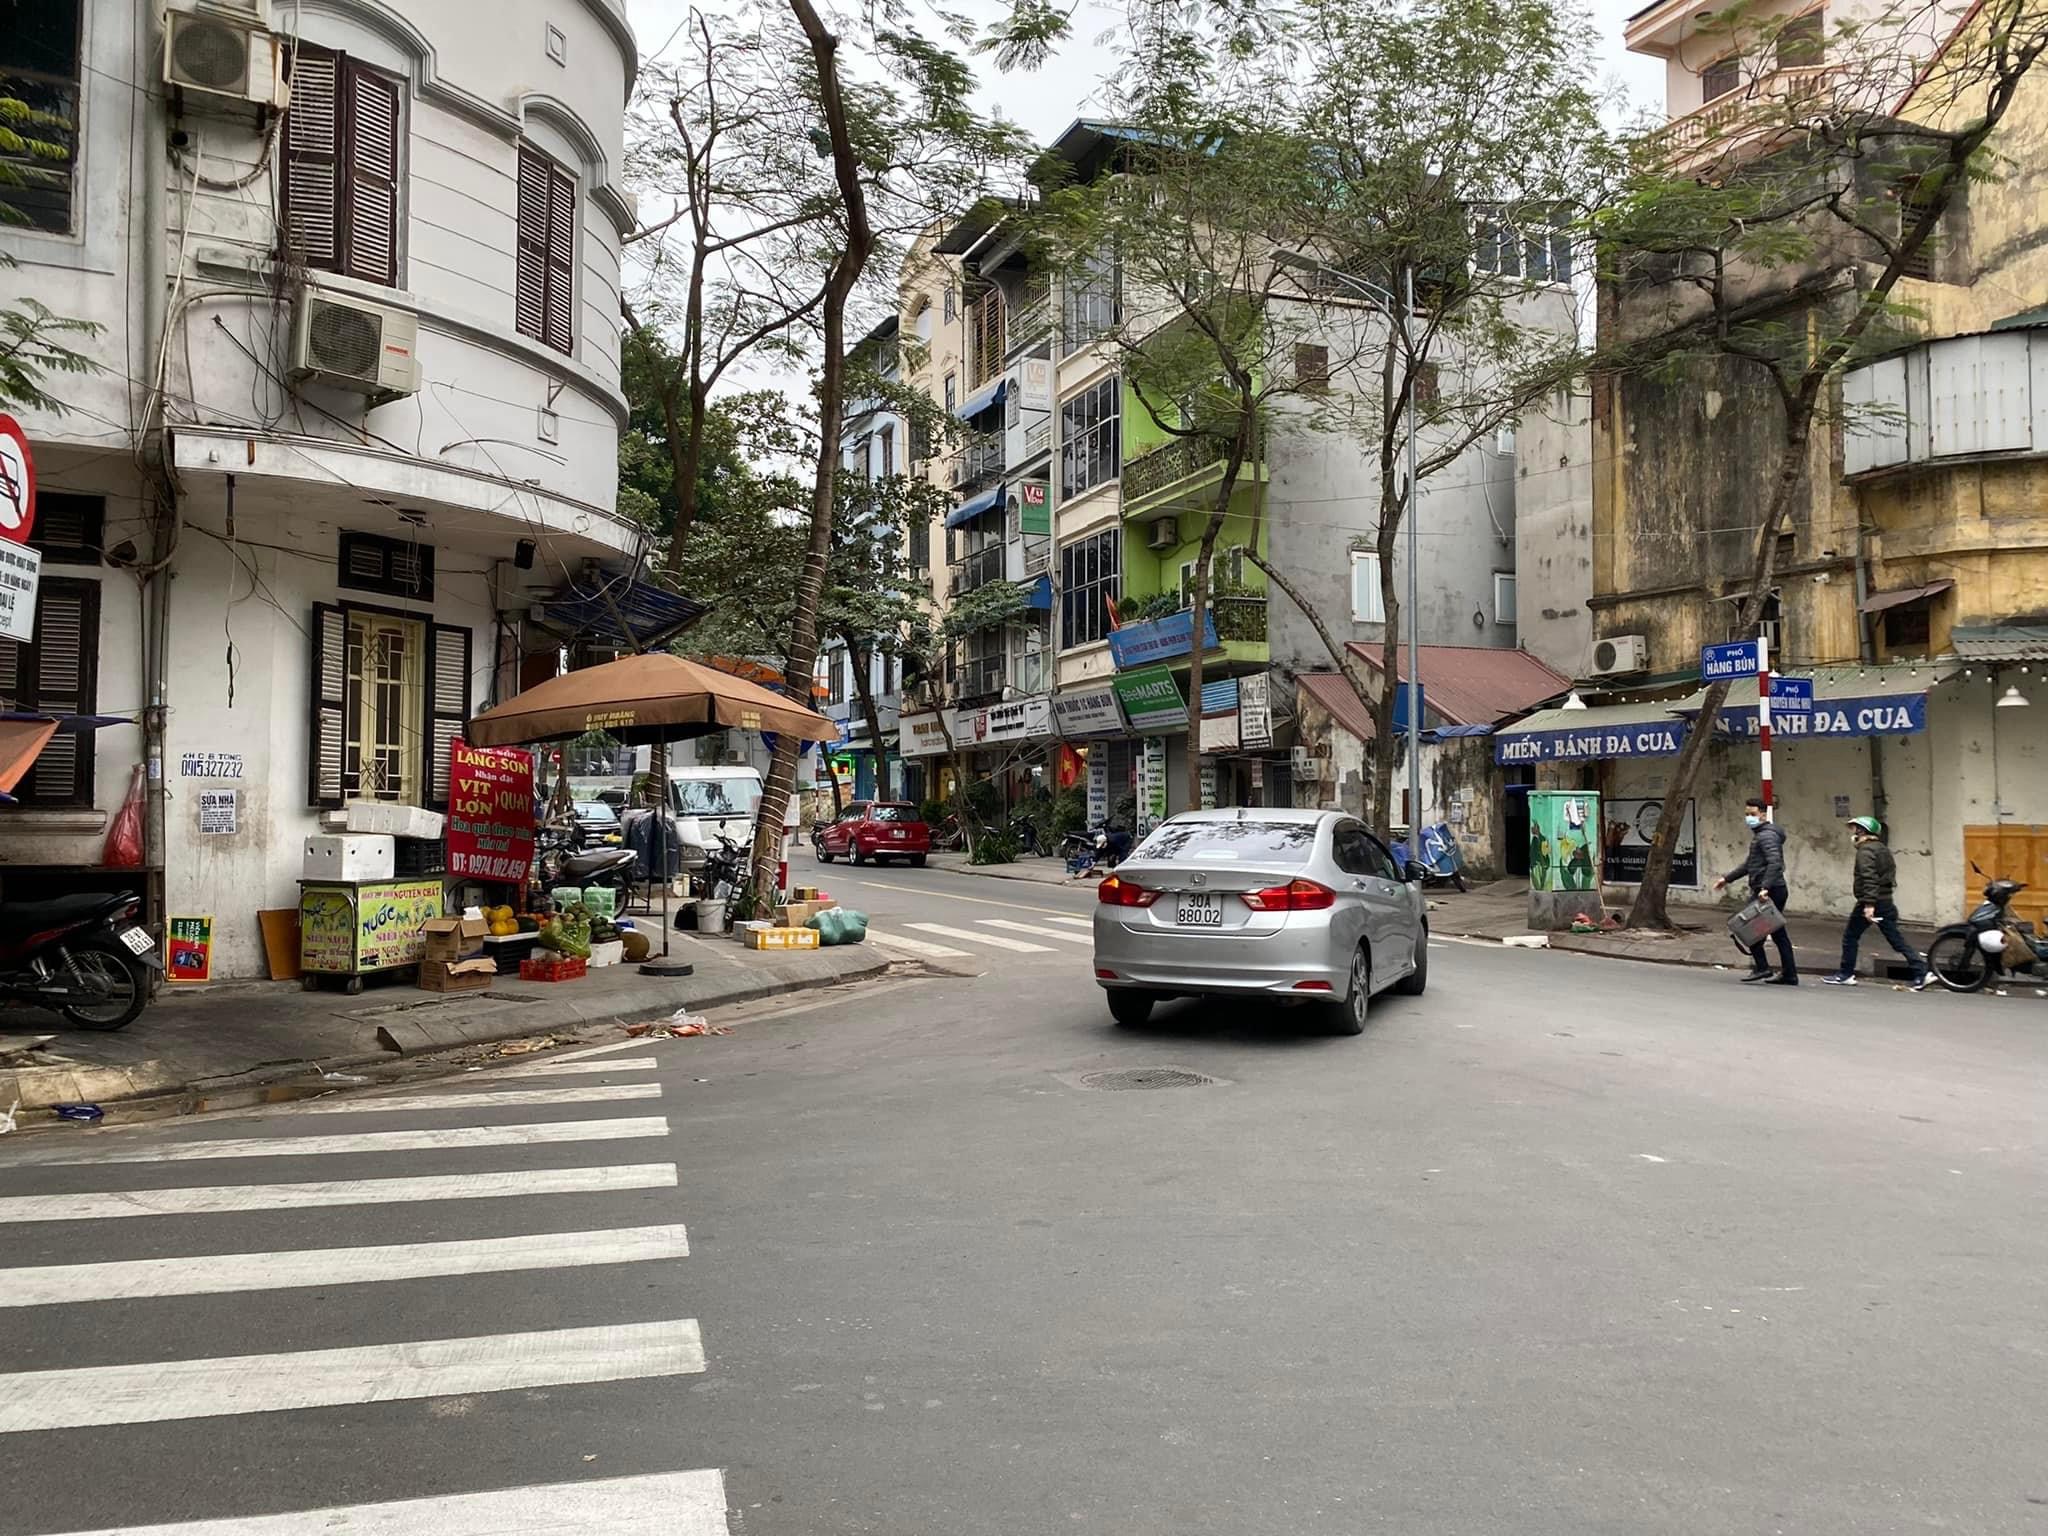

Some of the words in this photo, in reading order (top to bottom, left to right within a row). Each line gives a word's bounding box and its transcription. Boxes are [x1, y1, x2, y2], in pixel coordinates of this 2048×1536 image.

[1727, 647, 1743, 657] PHỐ
[1707, 659, 1732, 675] HÀNG
[1785, 684, 1799, 694] PHỐ
[1814, 712, 1851, 733] ĐA
[1857, 706, 1913, 730] CUA
[1502, 734, 1542, 760] MIẾN
[1554, 734, 1602, 757] BÁNH
[1606, 735, 1631, 754] ĐA
[1636, 732, 1676, 751] CUA
[181, 759, 243, 778] 0915327232
[457, 750, 496, 768] LẠNG
[500, 757, 529, 774] SƠN
[459, 779, 491, 797] VỊT
[201, 792, 217, 805] SỬA
[218, 793, 234, 805] NHÀ
[455, 798, 493, 817] LỢN
[451, 815, 471, 833] Hoa
[394, 888, 421, 900] NGUYÊN
[1188, 895, 1211, 908] 30A
[362, 902, 396, 937] NƯỚC
[1178, 909, 1220, 923] 880.02
